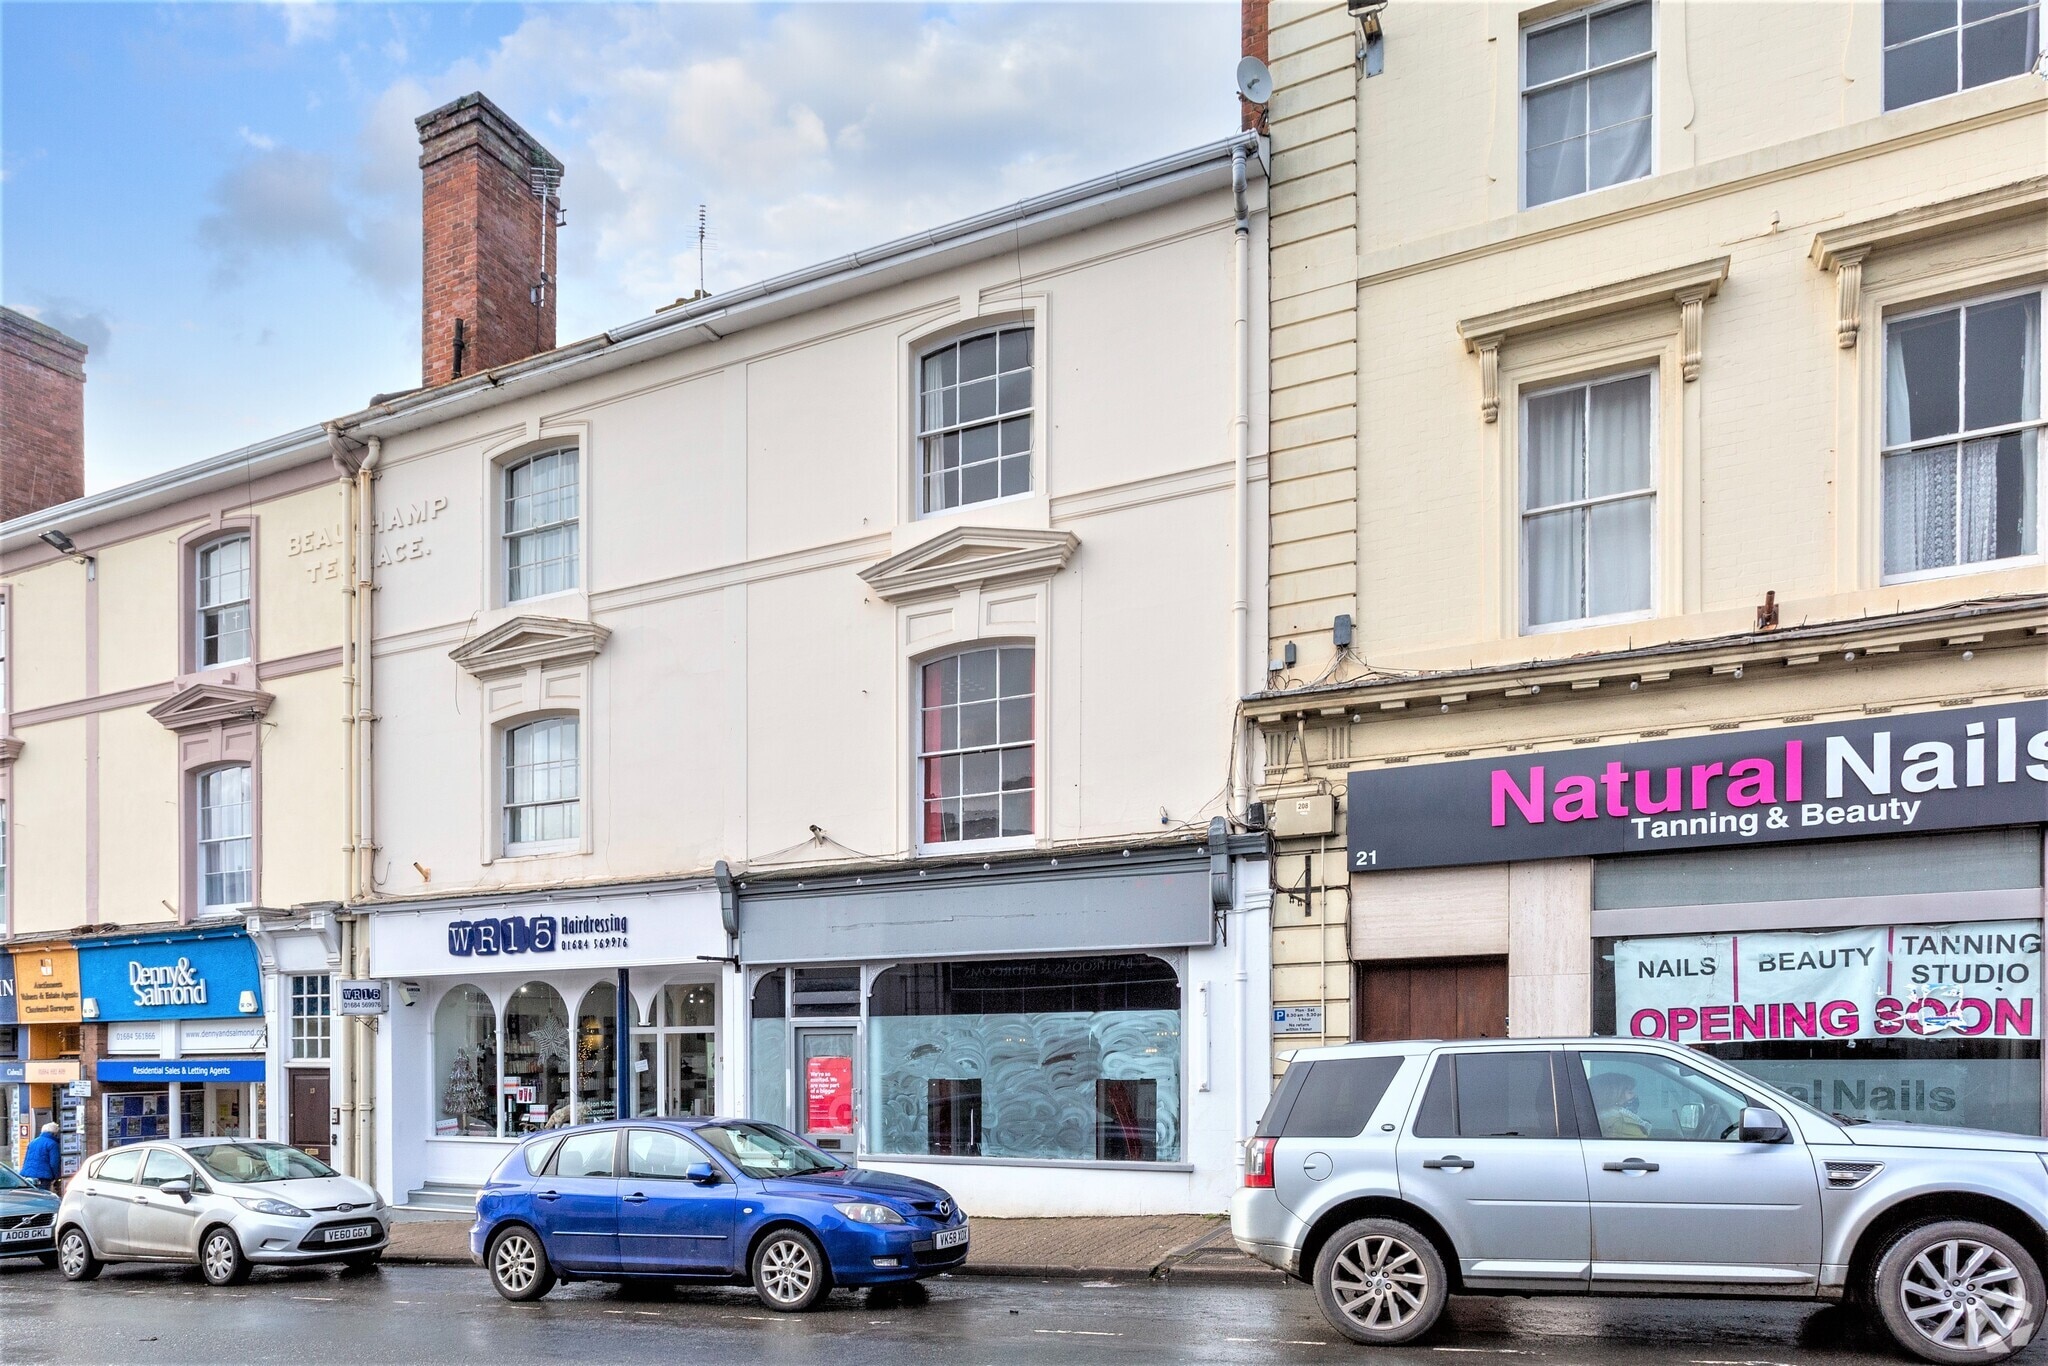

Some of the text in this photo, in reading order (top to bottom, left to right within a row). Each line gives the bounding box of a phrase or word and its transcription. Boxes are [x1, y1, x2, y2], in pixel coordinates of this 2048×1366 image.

[288, 496, 449, 557] BEAUHAMP
[307, 536, 432, 583] TEACE.
[1490, 740, 1803, 827] Natural
[1631, 798, 1921, 840] Tanning & Beauty
[1356, 850, 1377, 865] 21
[448, 918, 553, 953] WR15
[561, 913, 628, 935] Hairdressing
[561, 937, 628, 950] 01684 569976
[1901, 933, 2042, 956] TANNING
[1638, 946, 1876, 979] NAILS BEAUTY
[1911, 962, 2030, 984] STUDIO
[133, 978, 208, 1006] Salmond
[1629, 997, 2034, 1042] OPENING SOON
[116, 1032, 156, 1041] 01684 561866
[133, 1066, 231, 1077] Residential Sales & Letting Agents
[1833, 1079, 1956, 1112] Nails
[31, 1229, 48, 1238] GKL
[328, 1227, 368, 1240] VE60 GGX
